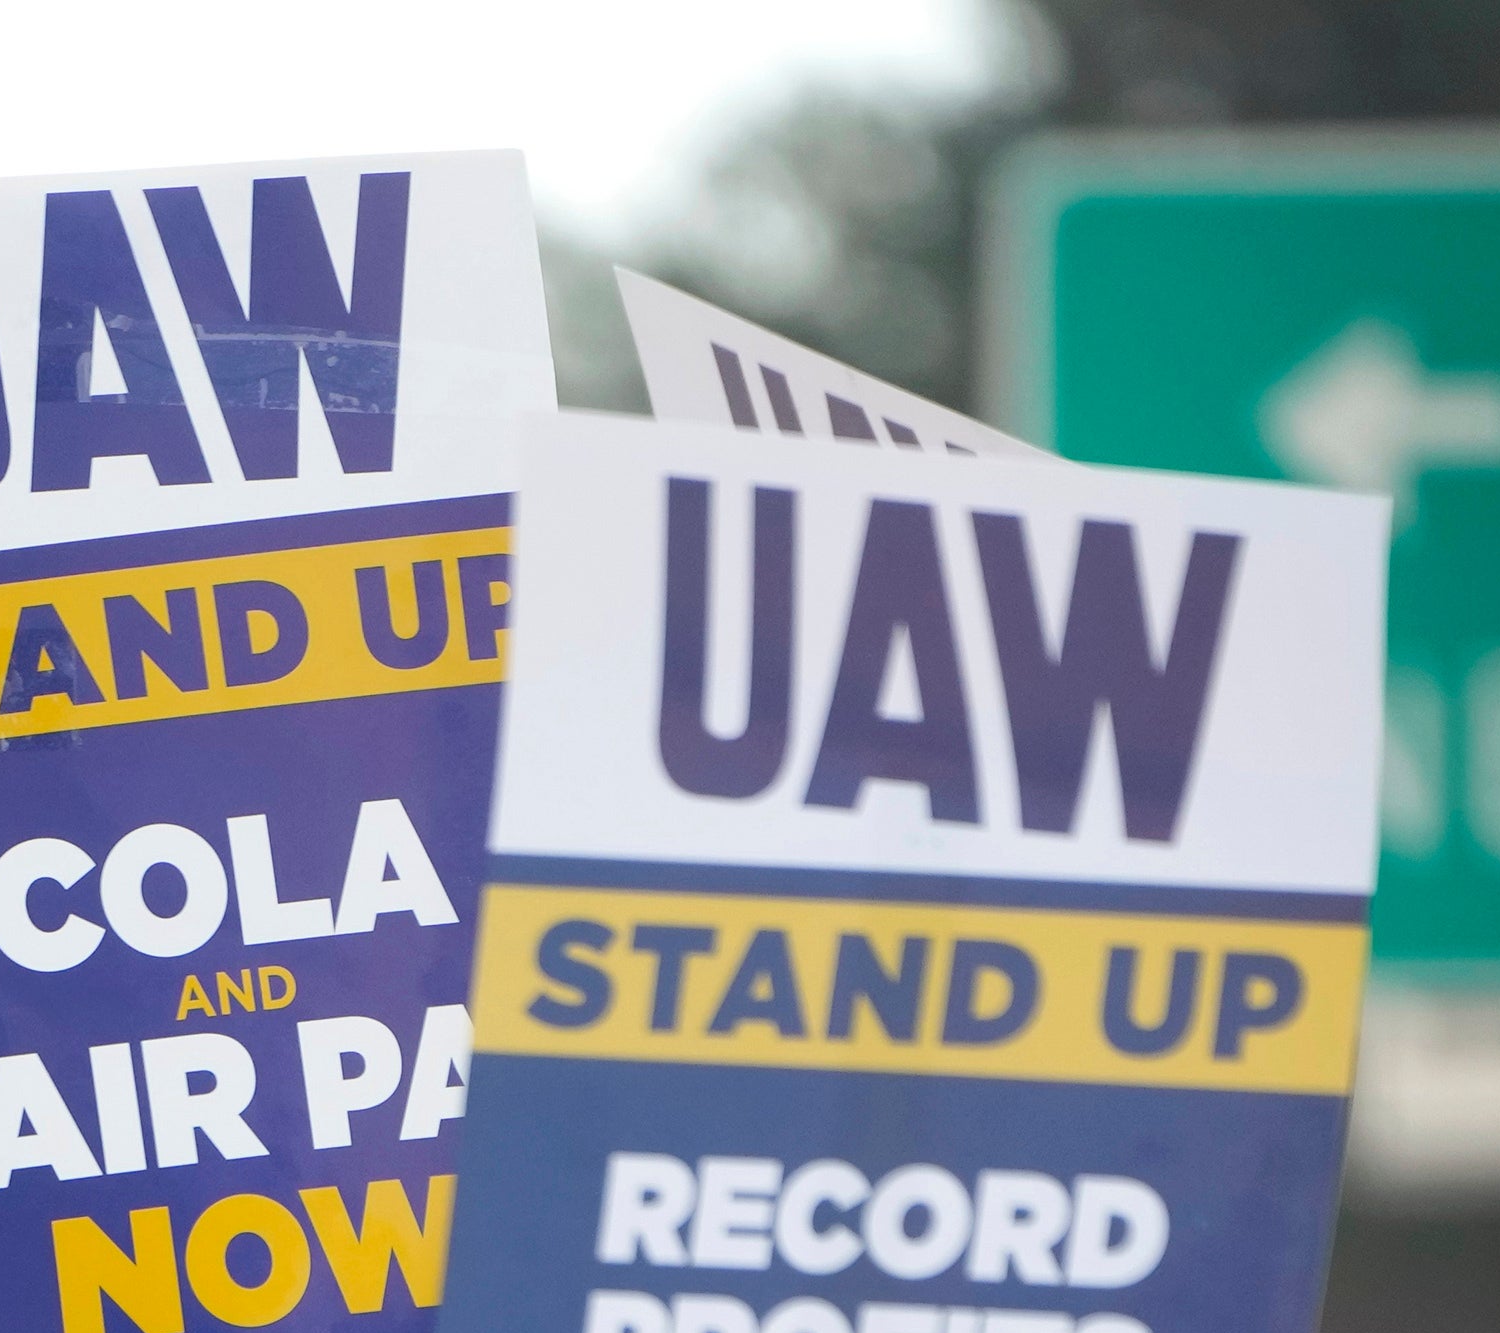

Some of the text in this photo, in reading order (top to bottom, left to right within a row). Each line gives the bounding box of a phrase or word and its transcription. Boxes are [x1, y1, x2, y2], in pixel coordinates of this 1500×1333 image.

[656, 475, 1244, 843] UAW
[176, 965, 297, 1021] AND
[525, 917, 1308, 1063] STAND UP
[595, 1151, 1171, 1289] RECORD
